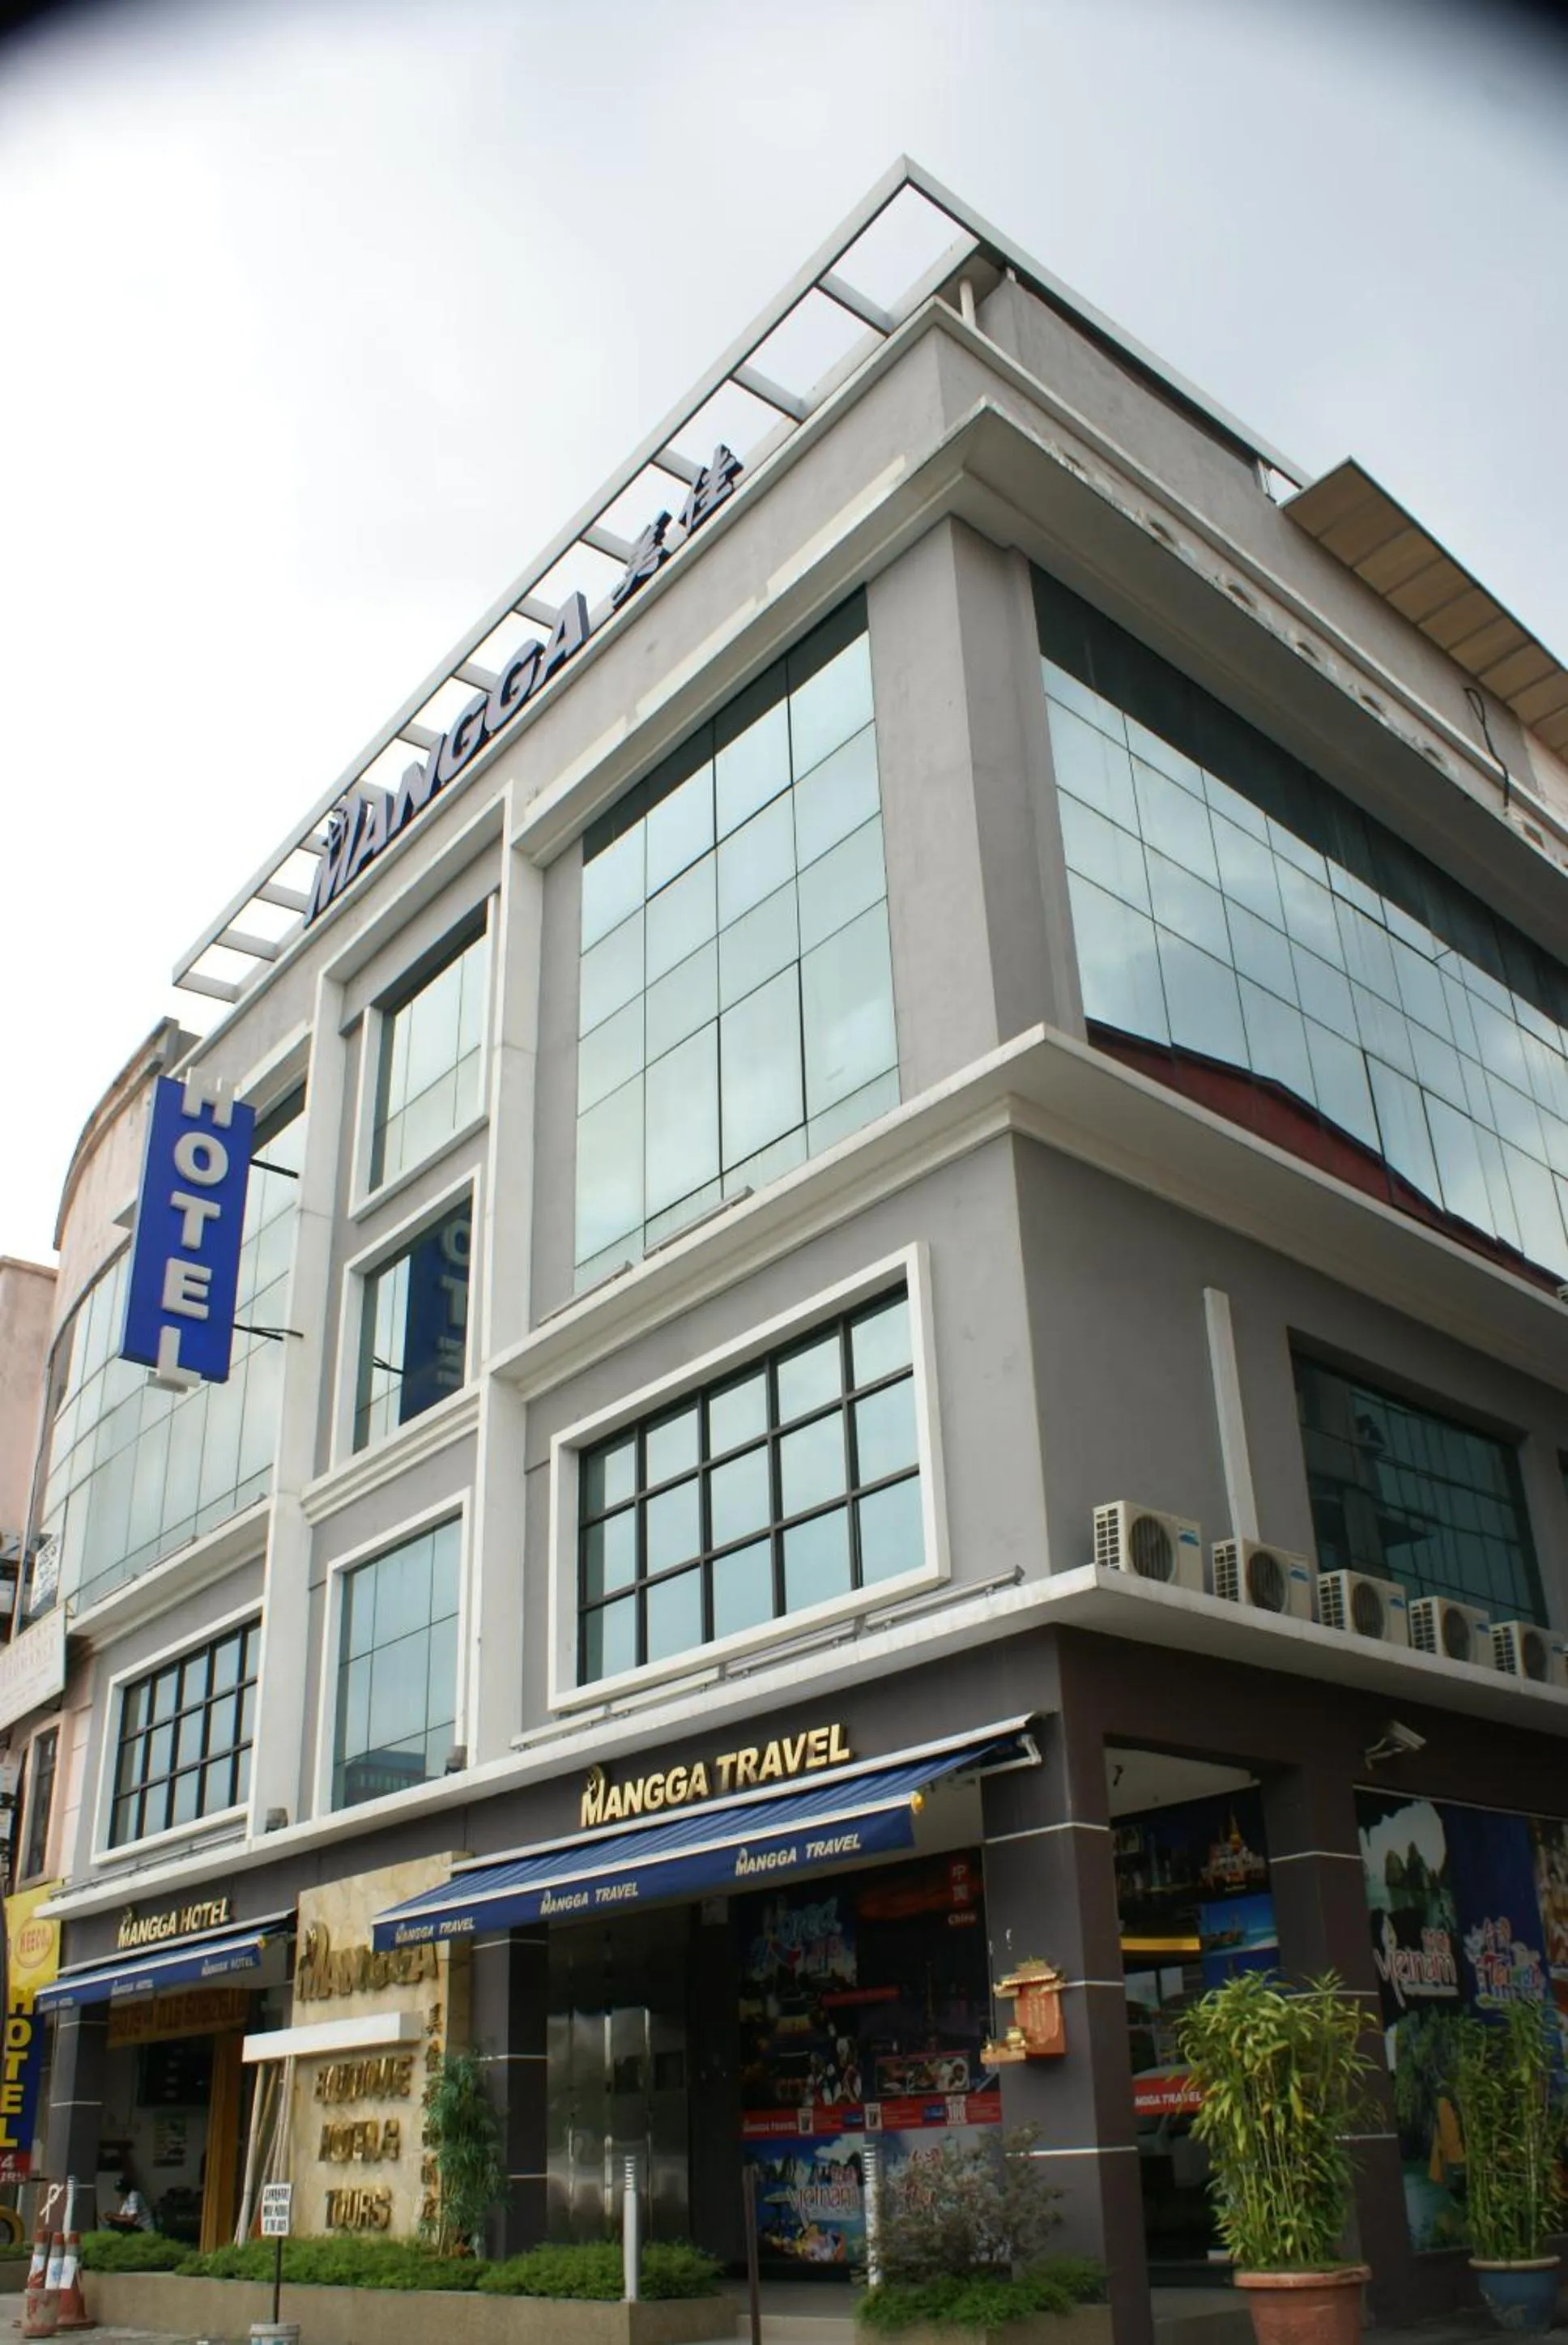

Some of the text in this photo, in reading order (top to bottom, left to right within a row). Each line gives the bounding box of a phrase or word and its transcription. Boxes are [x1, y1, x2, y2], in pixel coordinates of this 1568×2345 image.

[303, 591, 590, 930] MANGGA
[147, 1067, 239, 1393] HOTEL
[581, 1723, 851, 1827] MANGGA TRAVEL
[735, 1833, 862, 1876] MANGGA TRAVEL
[117, 1897, 229, 1948] MANGGA HOTEL
[540, 1882, 639, 1915] MANGGA TRAVEL
[439, 1917, 476, 1936] TRAVEL
[0, 1986, 34, 2148] HOTEL
[326, 2185, 392, 2229] TOURS
